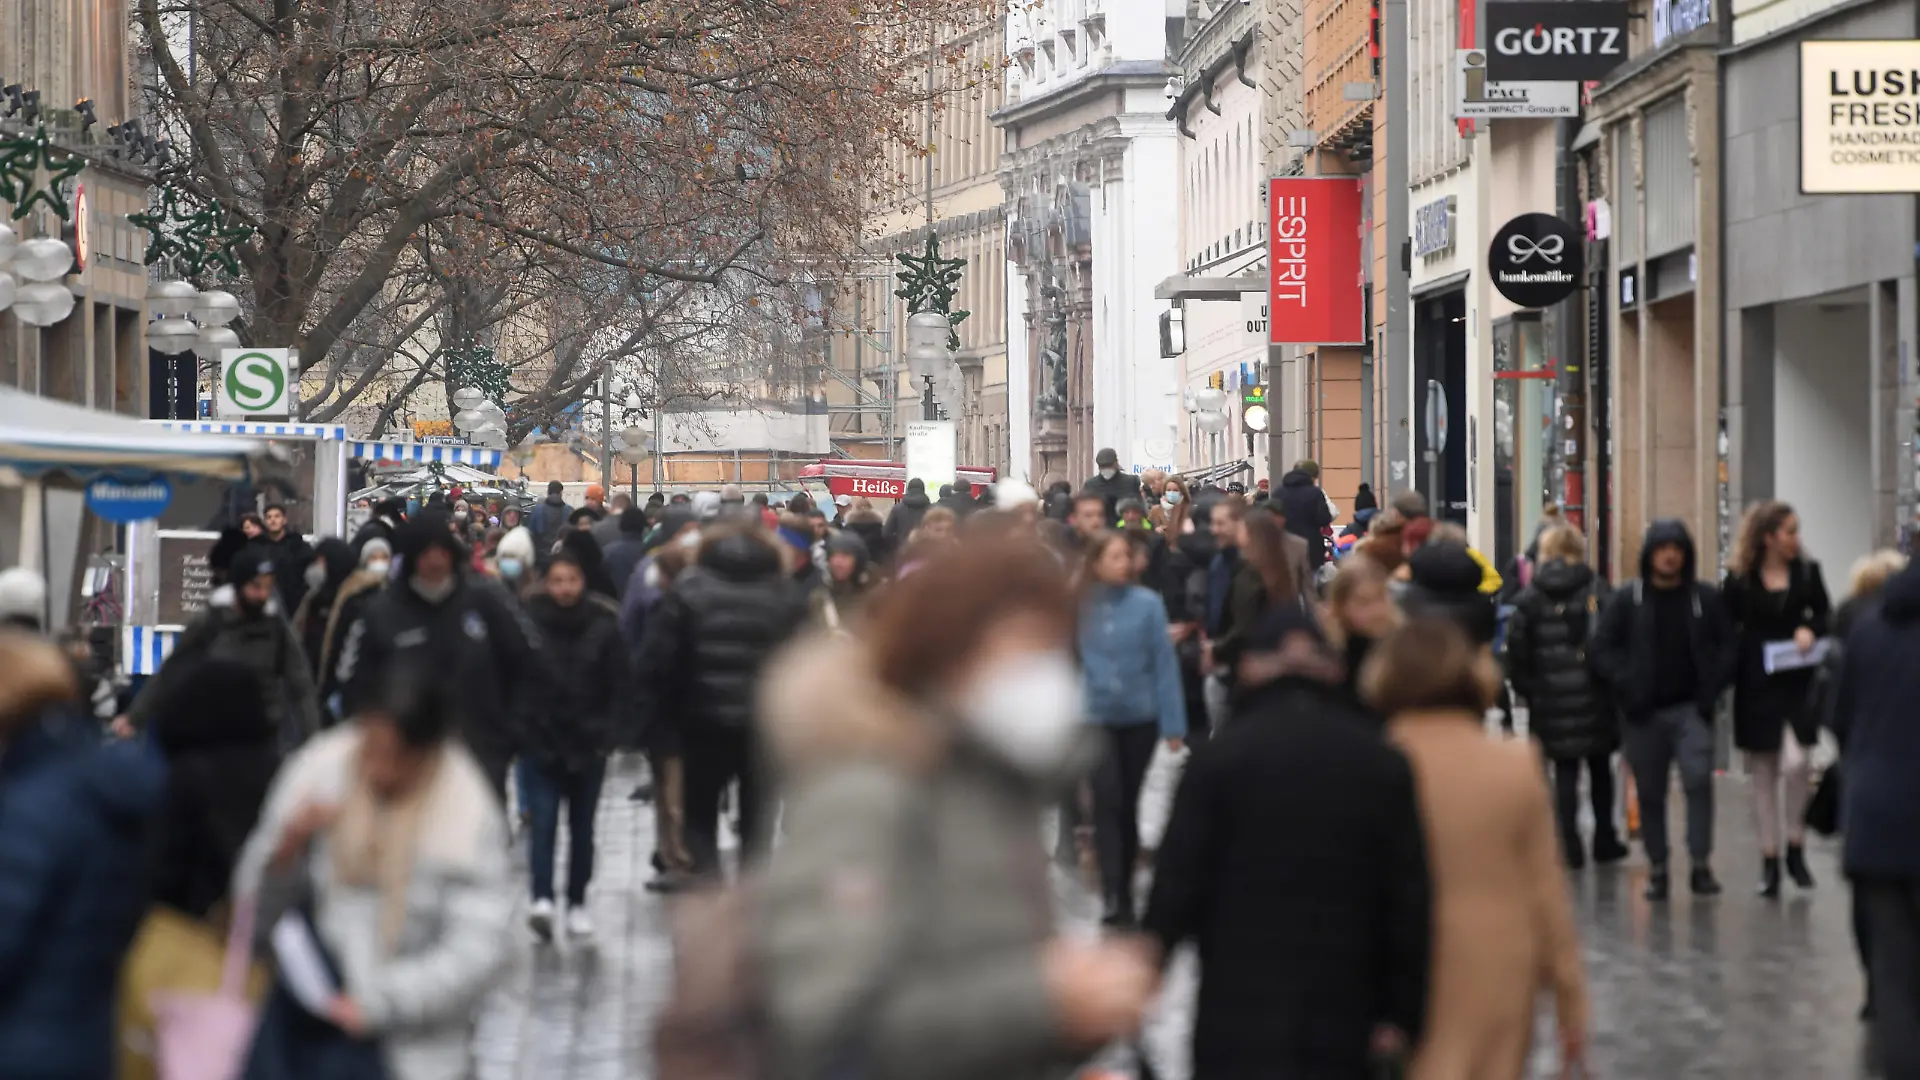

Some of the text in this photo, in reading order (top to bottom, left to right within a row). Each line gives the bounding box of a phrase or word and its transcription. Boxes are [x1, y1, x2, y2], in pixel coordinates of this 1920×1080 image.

[1830, 102, 1920, 126] FRES
[1278, 196, 1307, 307] ESPRIT
[233, 355, 277, 408] S
[852, 478, 899, 495] Heiße
